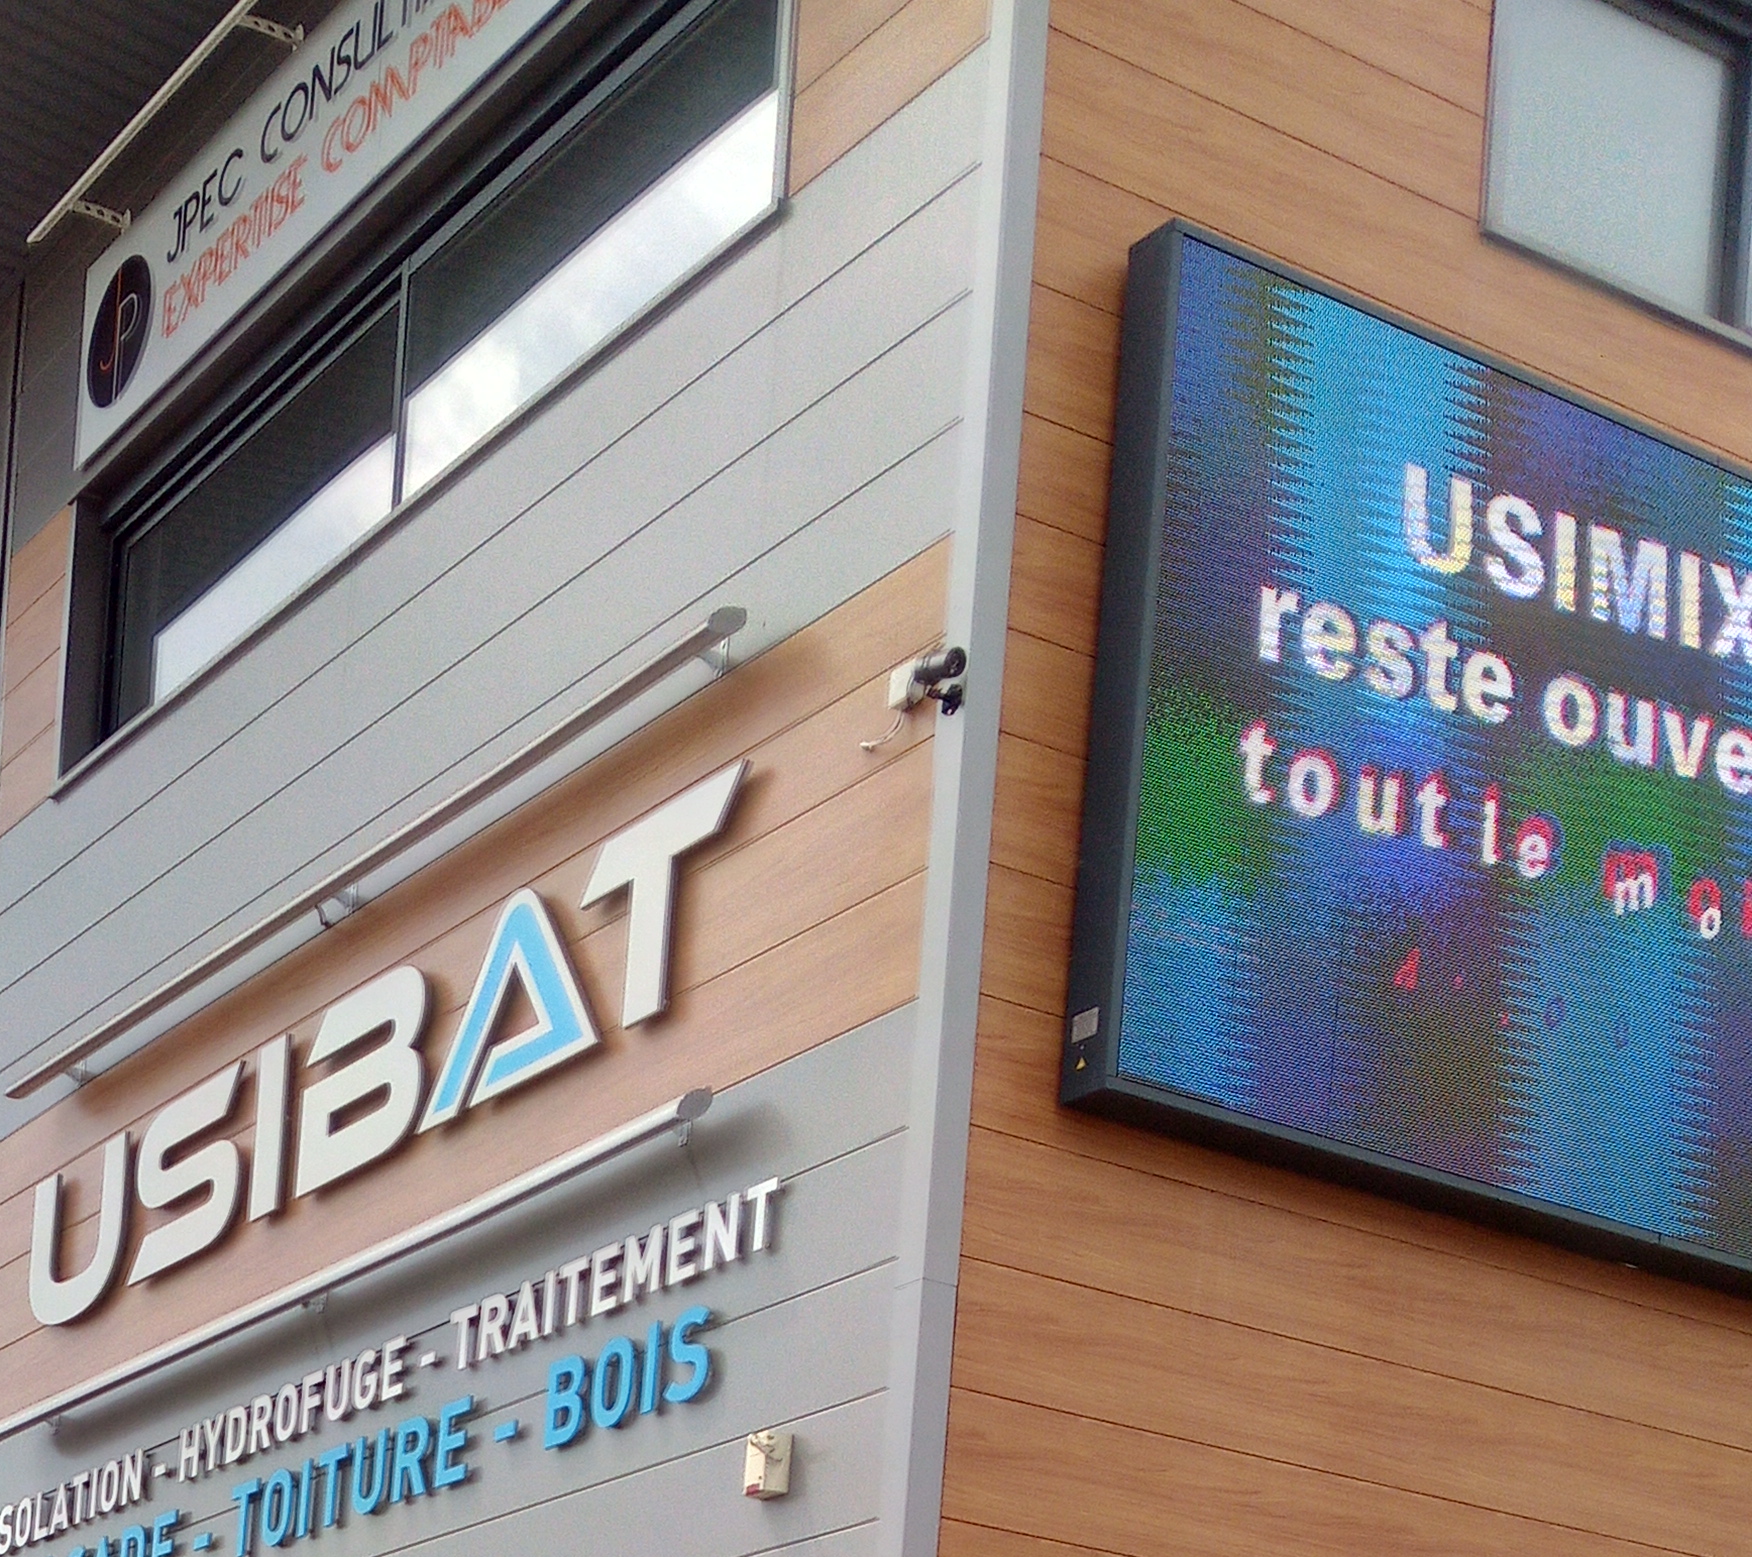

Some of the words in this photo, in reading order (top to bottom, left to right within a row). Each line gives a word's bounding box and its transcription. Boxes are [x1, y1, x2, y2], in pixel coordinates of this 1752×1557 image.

[161, 153, 309, 339] EXPERTISE
[167, 148, 245, 264] JPEC
[1257, 584, 1516, 727] reste
[1240, 718, 1451, 850] tout
[29, 758, 753, 1327] USIBAT
[178, 1334, 408, 1483] HYDROFUGE
[450, 1176, 781, 1371] TRAITEMENT
[544, 1305, 713, 1451] BOIS
